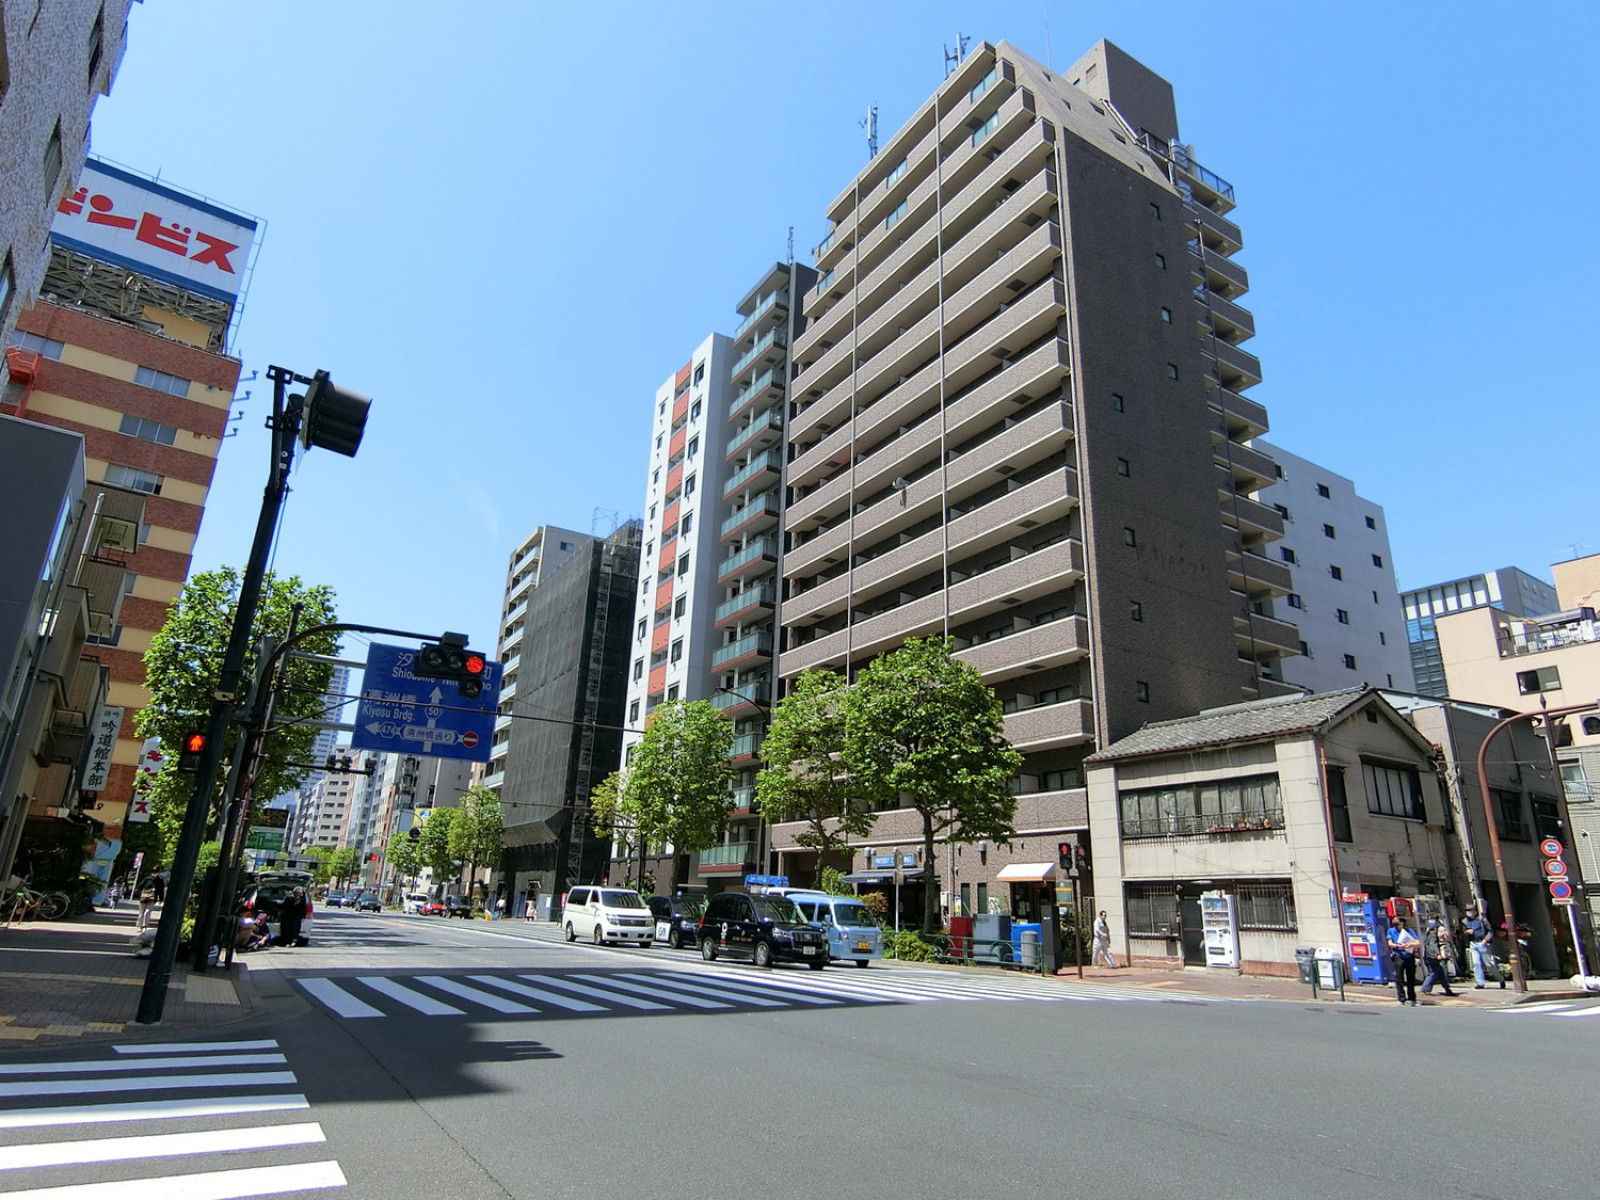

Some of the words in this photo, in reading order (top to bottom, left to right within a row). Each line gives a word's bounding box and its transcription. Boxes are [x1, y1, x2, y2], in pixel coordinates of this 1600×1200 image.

[362, 704, 391, 719] Kiyosu
[393, 708, 416, 723] Brdg.
[428, 706, 439, 715] 50
[381, 725, 395, 735] 474
